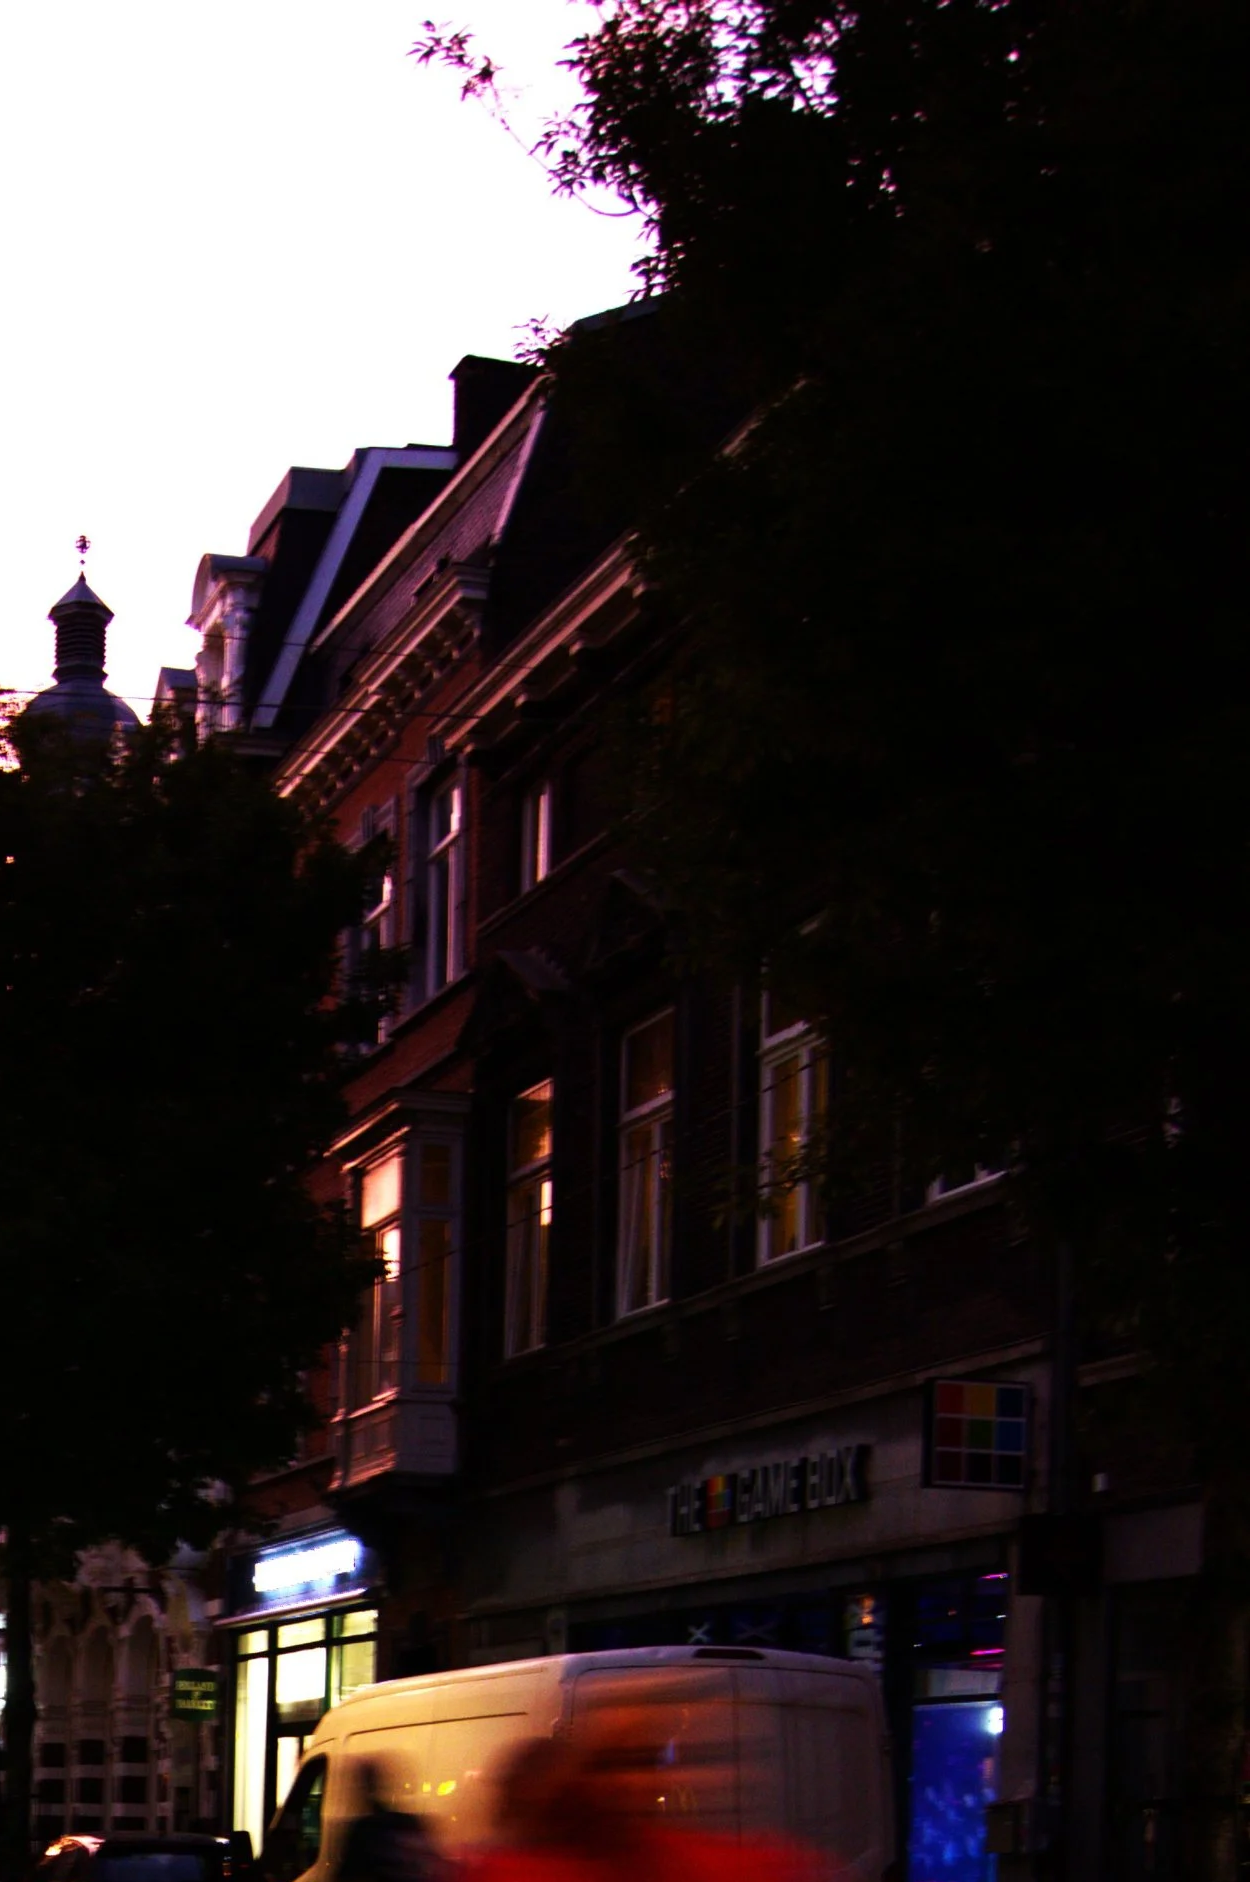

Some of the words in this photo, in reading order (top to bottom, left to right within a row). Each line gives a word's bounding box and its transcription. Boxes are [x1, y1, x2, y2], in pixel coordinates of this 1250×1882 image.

[665, 1481, 703, 1535] THE
[736, 1457, 802, 1523] GAME
[806, 1445, 865, 1510] BOX
